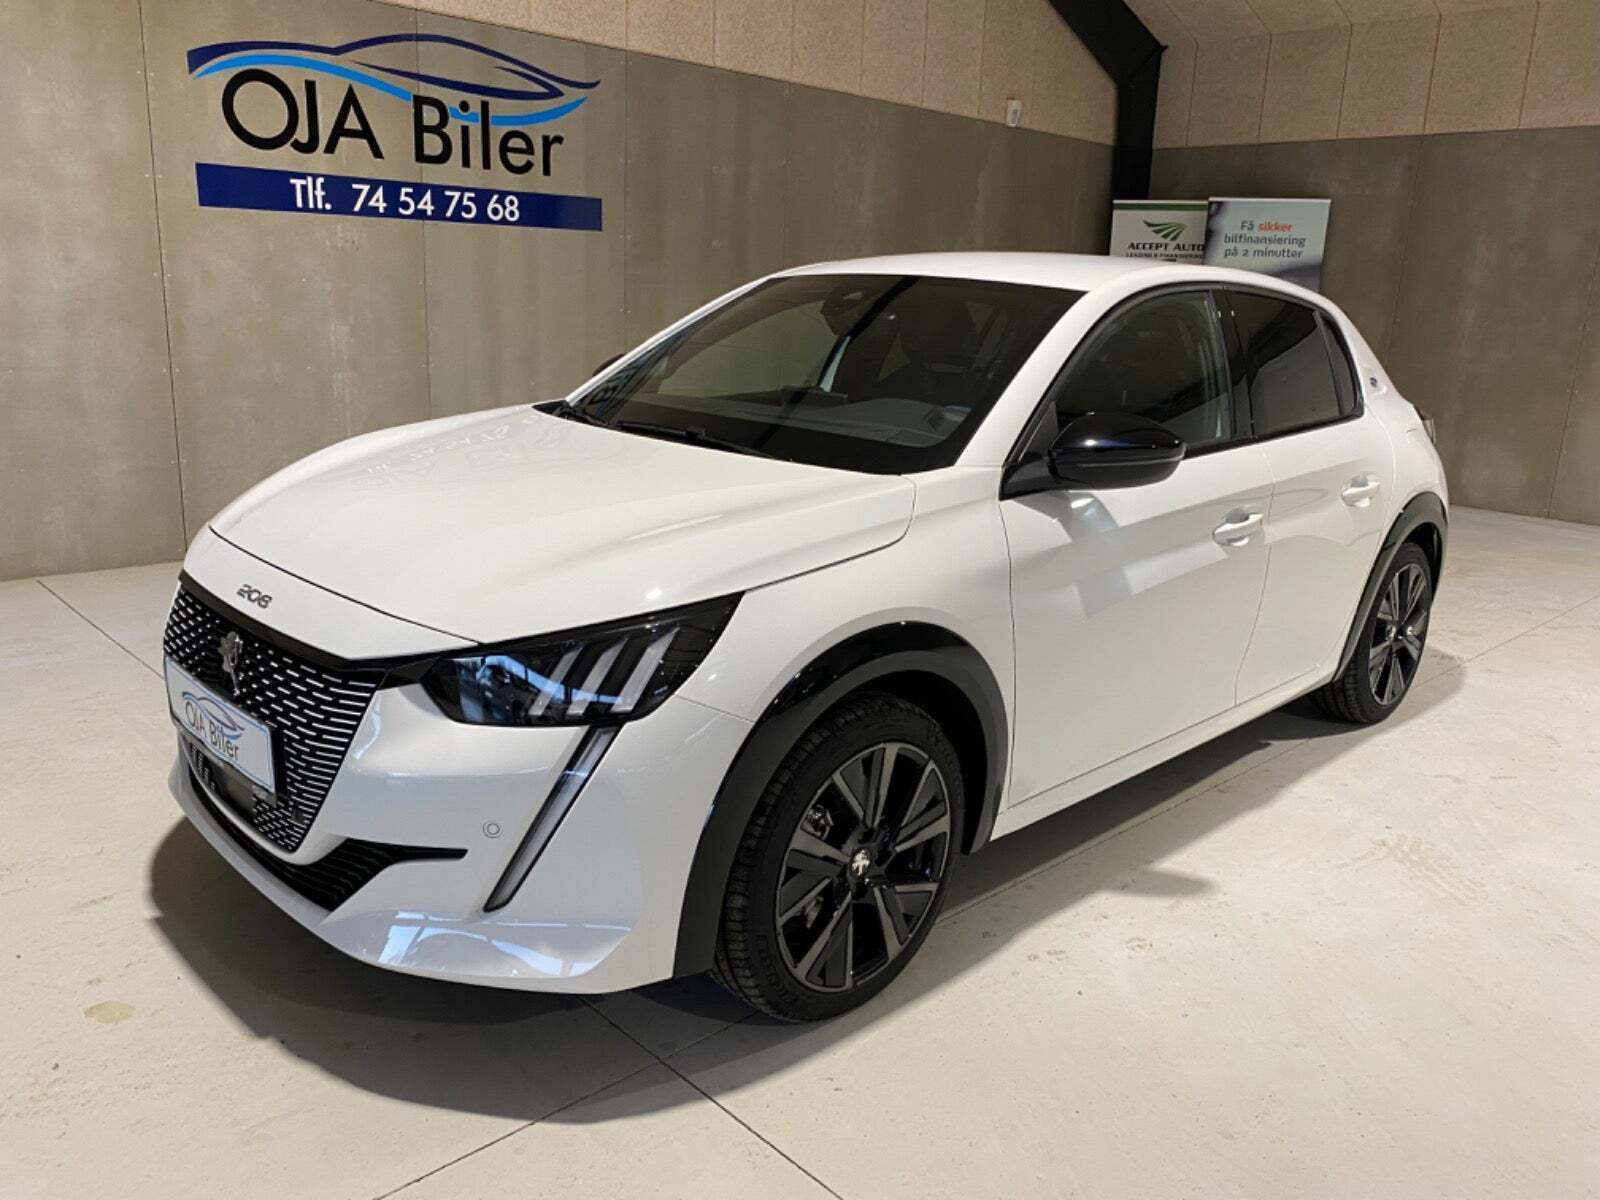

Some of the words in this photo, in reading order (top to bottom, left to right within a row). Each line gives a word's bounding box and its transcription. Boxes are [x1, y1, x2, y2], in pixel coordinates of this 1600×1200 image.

[222, 68, 384, 160] OJA
[411, 94, 564, 176] Biler
[290, 176, 332, 210] Tlf.
[351, 184, 387, 213] 74
[398, 187, 434, 216] 54
[444, 190, 477, 219] 75
[487, 195, 519, 222] 68
[1240, 220, 1254, 231] Få
[1258, 221, 1293, 232] sikker
[1127, 242, 1169, 250] ACCEPT
[1173, 243, 1206, 251] AUTO
[1223, 233, 1306, 248] bilfinansiering
[1224, 246, 1238, 258] på
[1242, 249, 1249, 257] 2
[1253, 247, 1304, 258] minutter
[236, 584, 272, 608] 208
[185, 701, 207, 739] OJA
[209, 720, 240, 761] Biler
